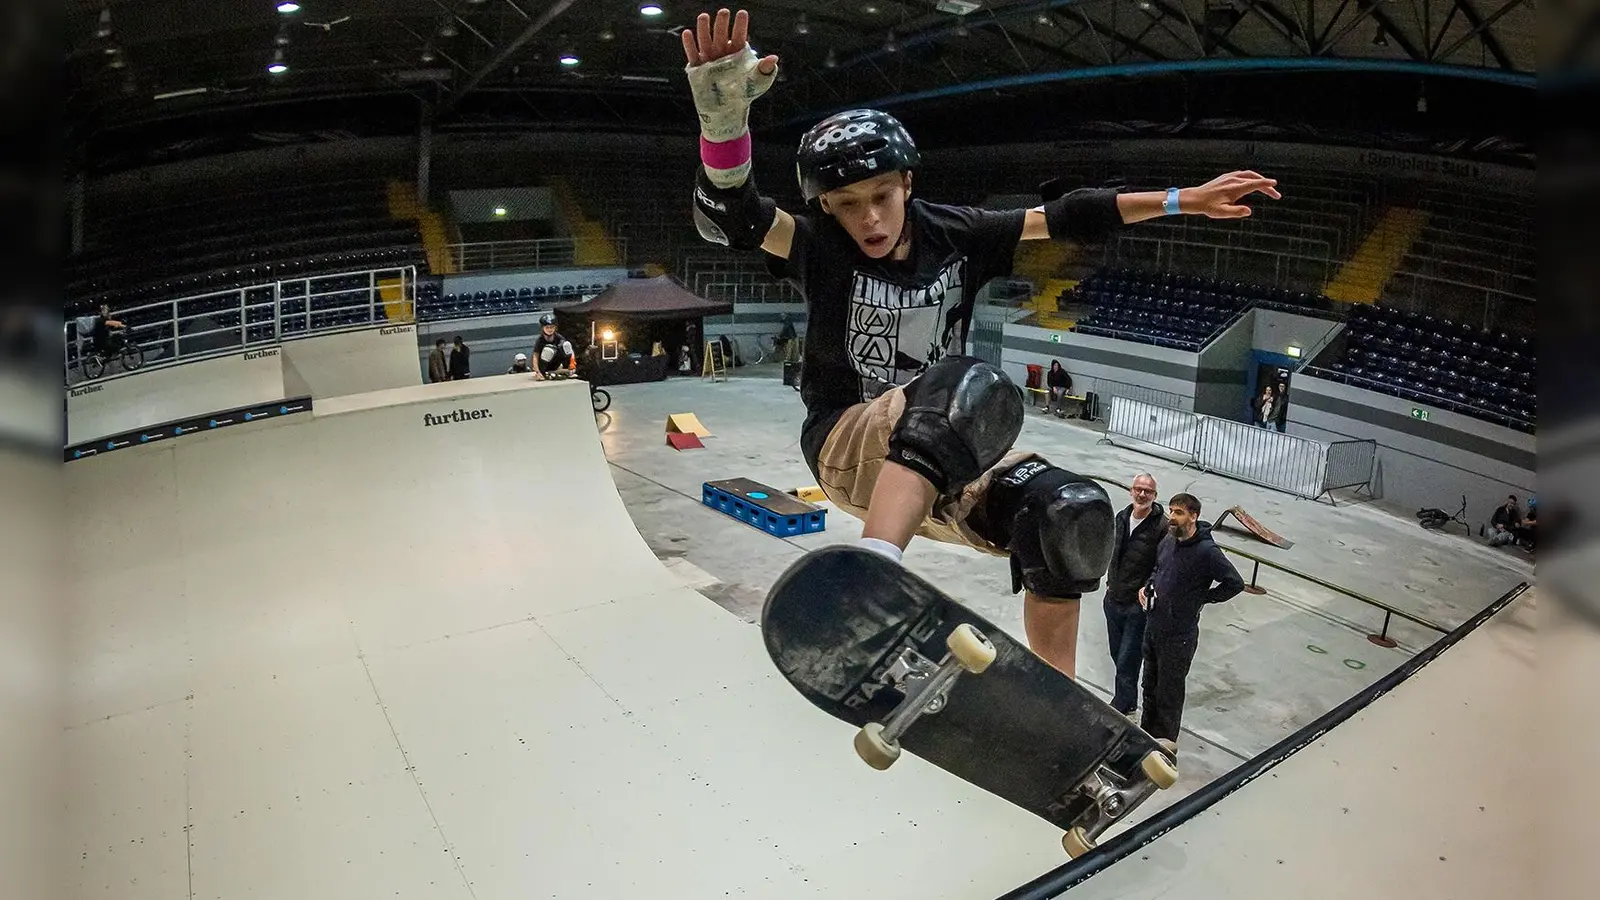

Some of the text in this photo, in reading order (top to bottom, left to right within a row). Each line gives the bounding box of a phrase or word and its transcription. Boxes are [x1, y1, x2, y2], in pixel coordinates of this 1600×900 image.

[815, 122, 877, 151] dope
[244, 350, 279, 361] further.
[424, 409, 493, 427] further.
